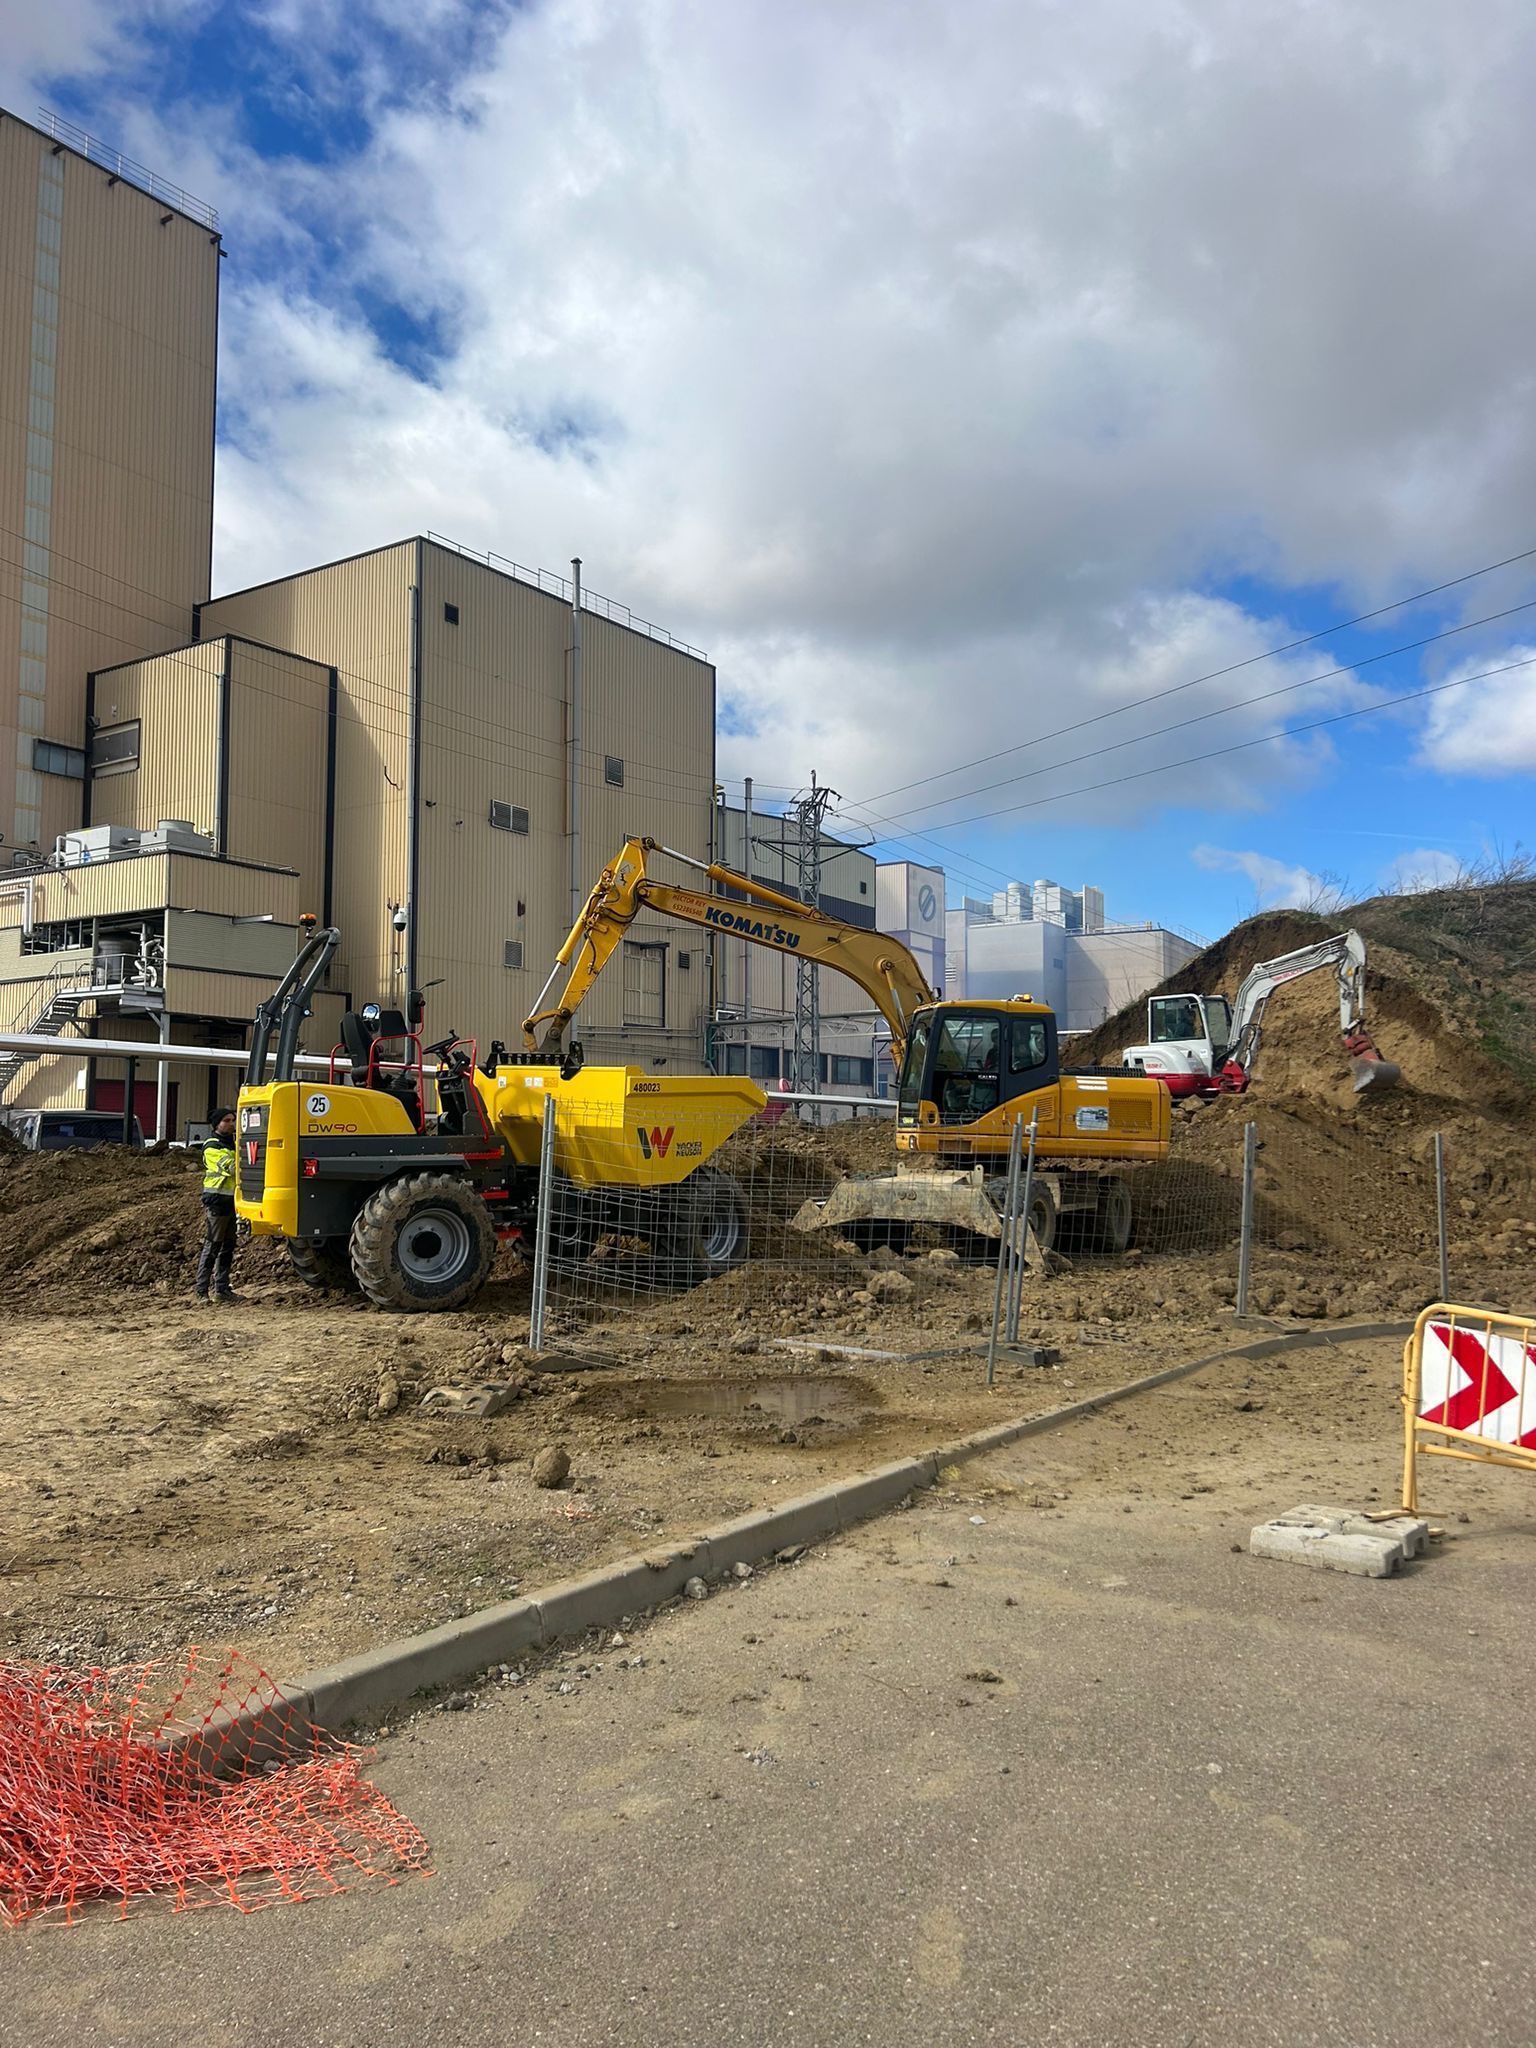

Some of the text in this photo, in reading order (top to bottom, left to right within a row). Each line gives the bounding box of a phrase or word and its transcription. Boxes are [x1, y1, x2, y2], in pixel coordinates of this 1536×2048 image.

[705, 906, 800, 949] KOMATSU
[633, 1082, 661, 1093] 480023
[311, 1097, 326, 1113] 25
[308, 1123, 358, 1133] DW90
